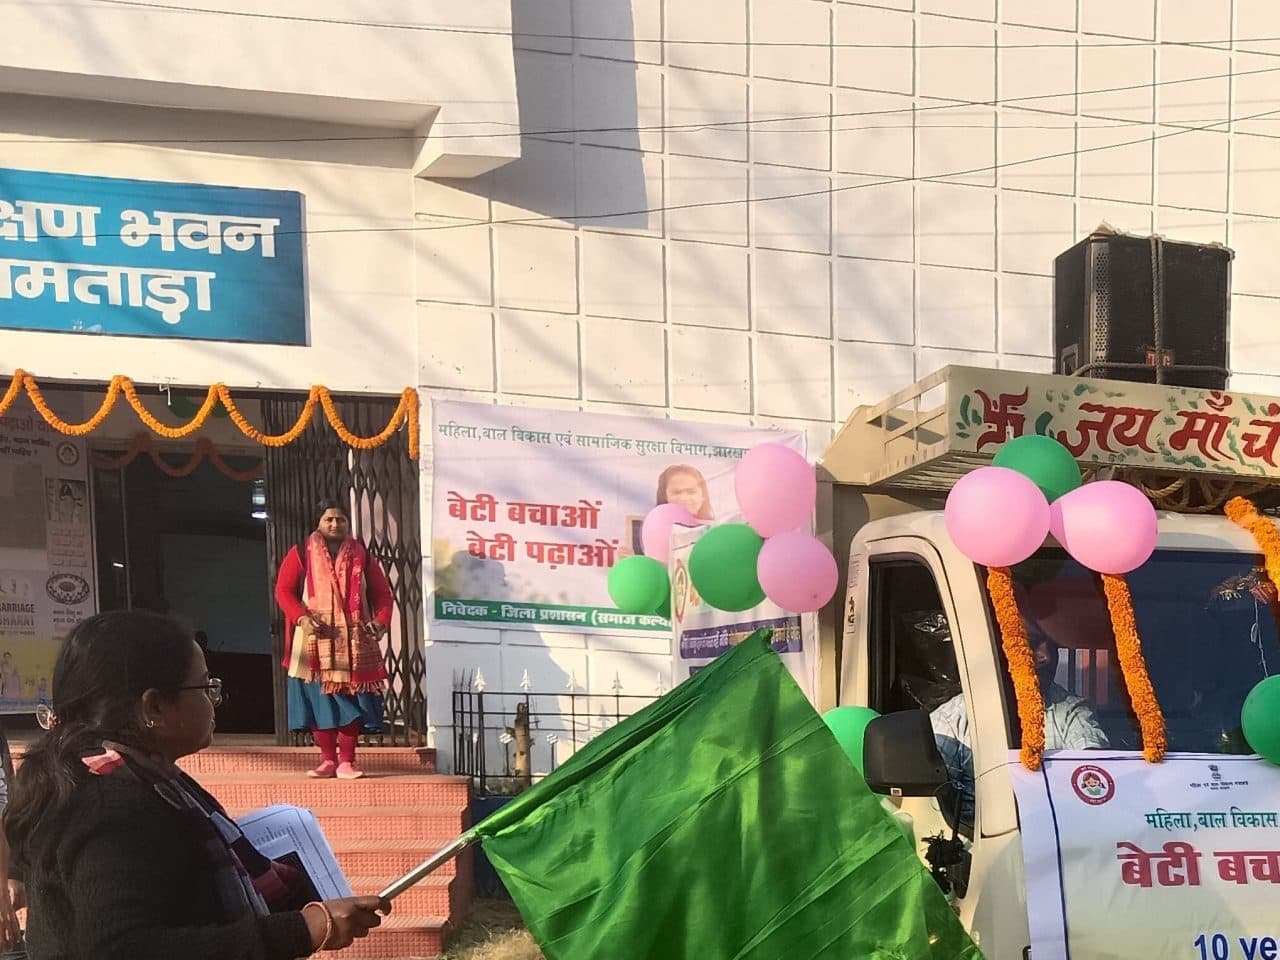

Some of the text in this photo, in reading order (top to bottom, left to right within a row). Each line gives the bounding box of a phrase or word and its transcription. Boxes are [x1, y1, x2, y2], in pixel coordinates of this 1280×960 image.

[119, 208, 280, 258] भवन
[0, 258, 216, 324] ामताड़ा
[512, 426, 551, 444] विकास
[555, 430, 572, 446] एवं
[576, 433, 632, 449] सामाजिक
[635, 439, 667, 456] सुरक्षा
[1057, 403, 1160, 457] जय
[1169, 390, 1236, 462] माँ
[447, 491, 602, 529] बेटी बचाओं
[466, 531, 619, 570] बेटी पढ़ाओं
[0, 603, 35, 614] ARRIAGE
[442, 601, 488, 616] निवेदक
[501, 605, 535, 620] जिला
[540, 609, 587, 623] प्रशासन
[639, 614, 672, 627] कल्या
[1230, 806, 1277, 828] विकास
[1117, 841, 1202, 888] बेटी
